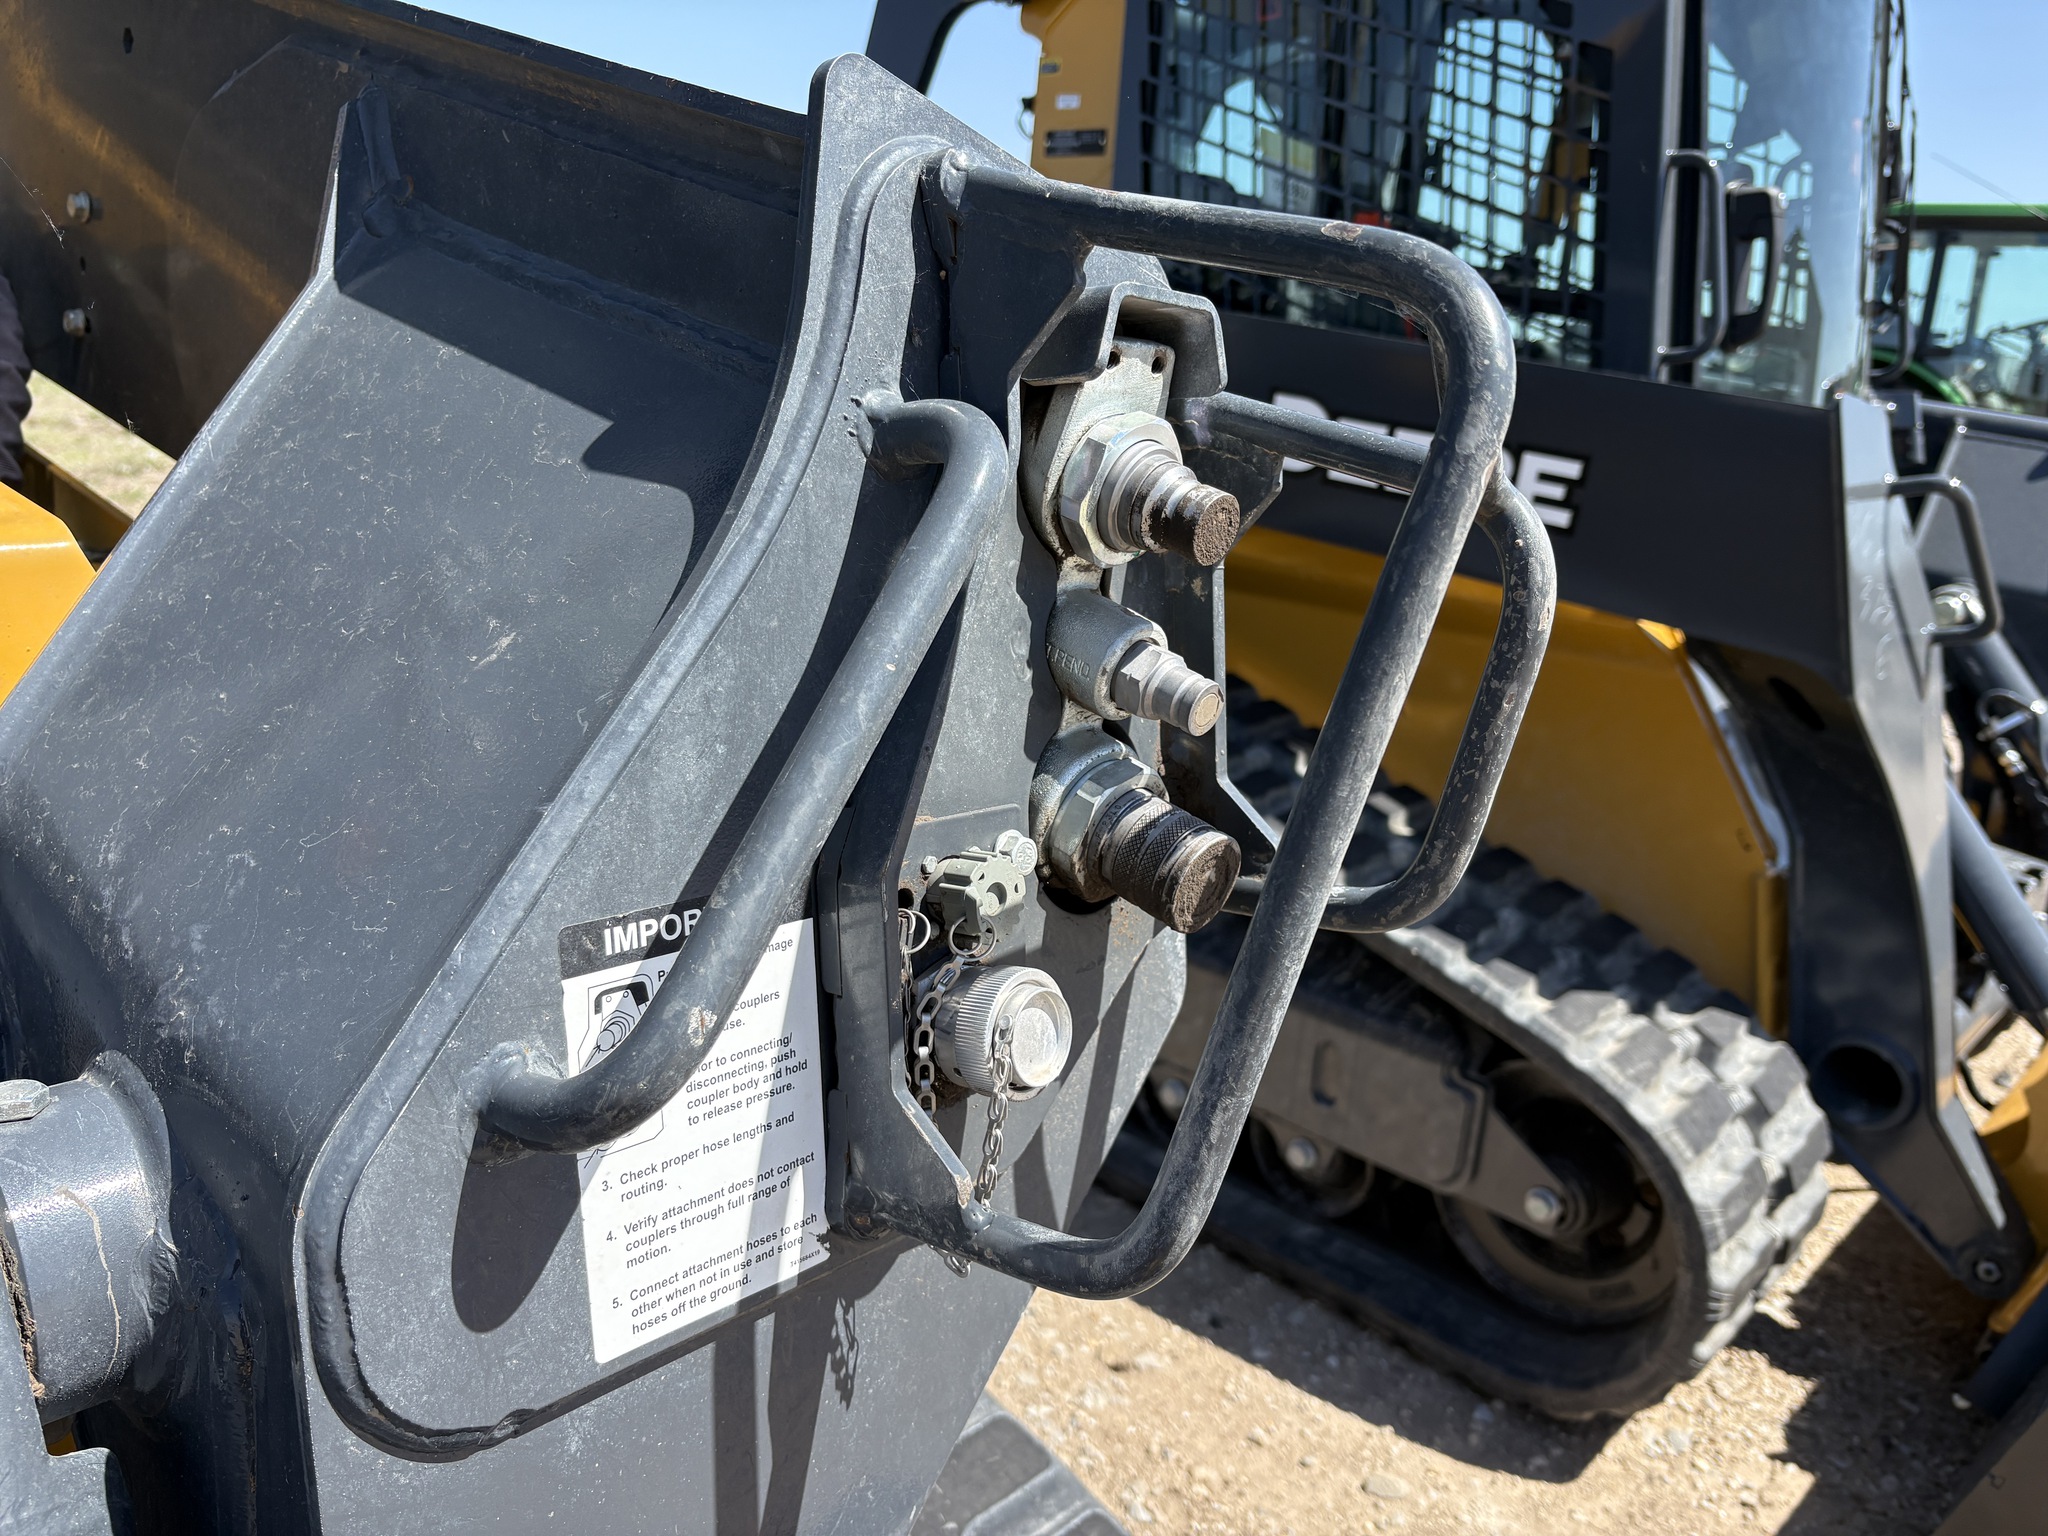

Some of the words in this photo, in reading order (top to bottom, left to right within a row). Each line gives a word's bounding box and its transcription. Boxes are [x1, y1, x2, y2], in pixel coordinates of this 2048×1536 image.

[604, 908, 702, 956] IMPOR
[734, 989, 780, 1012] couplers
[685, 1060, 768, 1094] disconnecting,
[770, 1048, 797, 1069] push
[715, 1056, 728, 1070] to
[730, 1032, 793, 1062] connecting/
[687, 1087, 730, 1111] coupler
[732, 1074, 760, 1097] body
[762, 1068, 783, 1084] and
[784, 1059, 808, 1078] hold
[688, 1114, 700, 1127] to
[702, 1100, 743, 1122] release
[746, 1082, 796, 1108] pressure.
[601, 1180, 613, 1192] 3.
[619, 1162, 658, 1187] Check
[661, 1147, 700, 1173] proper
[702, 1135, 731, 1155] hose
[733, 1121, 773, 1143] lengths
[775, 1111, 795, 1128] and
[606, 1231, 617, 1243] 4.
[623, 1213, 658, 1236] Verify
[661, 1187, 725, 1222] attachment
[727, 1177, 755, 1195] does
[756, 1168, 775, 1184] not
[776, 1151, 815, 1175] contact
[620, 1178, 668, 1203] routing.
[625, 1224, 677, 1253] couplers
[680, 1204, 725, 1230] through
[727, 1194, 745, 1211] full
[747, 1183, 778, 1203] range
[779, 1175, 791, 1190] of
[612, 1297, 623, 1310] 5.
[629, 1272, 679, 1302] Connect
[681, 1244, 744, 1280] attachment
[746, 1232, 778, 1252] hoses
[780, 1226, 791, 1239] to
[793, 1212, 818, 1231] each
[625, 1245, 672, 1269] motion.
[630, 1297, 662, 1318] other
[665, 1283, 697, 1304] when
[699, 1272, 718, 1290] not
[720, 1267, 731, 1282] in
[733, 1257, 753, 1273] use
[755, 1246, 775, 1264] and
[777, 1235, 804, 1254] store
[632, 1314, 668, 1335] hoses
[671, 1302, 687, 1317] off
[689, 1292, 707, 1311] the
[710, 1275, 752, 1302] ground.
